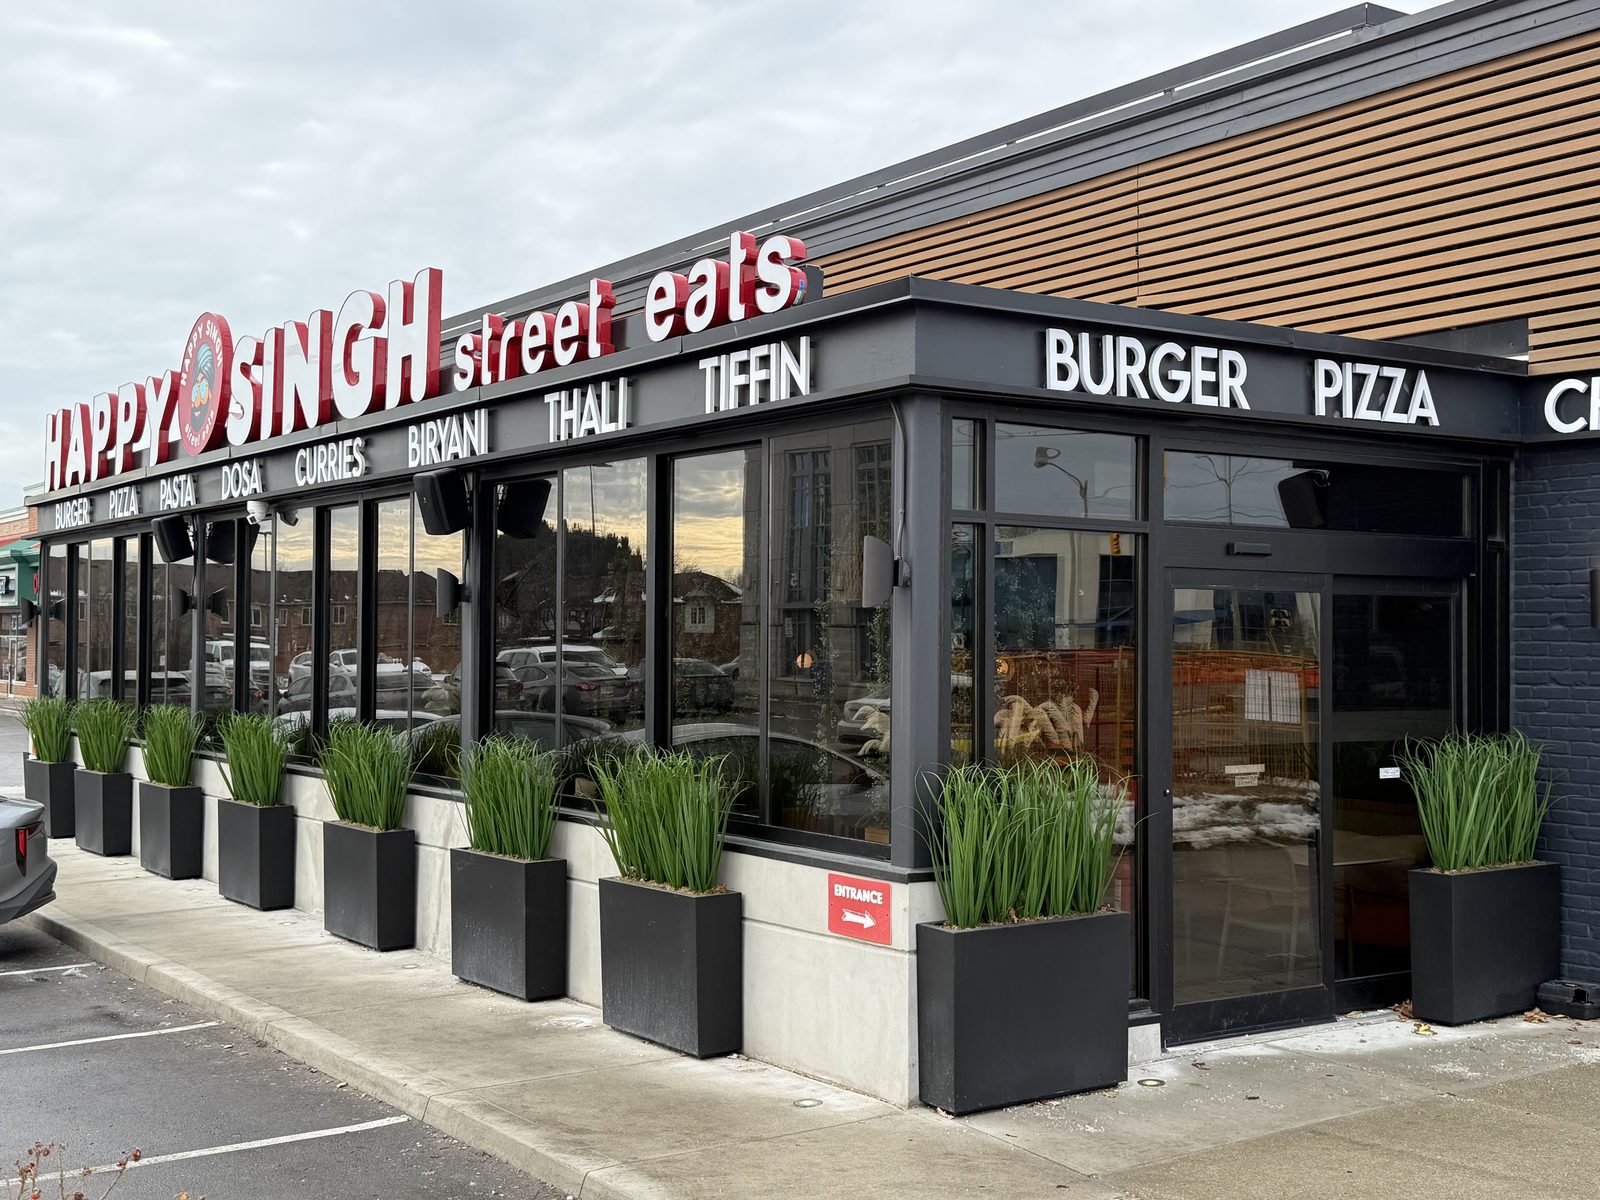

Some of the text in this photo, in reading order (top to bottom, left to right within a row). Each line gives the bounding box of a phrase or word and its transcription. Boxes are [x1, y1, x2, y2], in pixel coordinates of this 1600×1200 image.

[44, 230, 807, 494] HAPPY SINGH street eats
[180, 322, 203, 386] HAPPY
[1045, 327, 1441, 427] BURGER PIZZA
[55, 336, 812, 530] BURGER PIZZA PASTA DOSA CURRIES BIRYANI THALI TIFFIN
[834, 883, 884, 905] ENTRANCE
